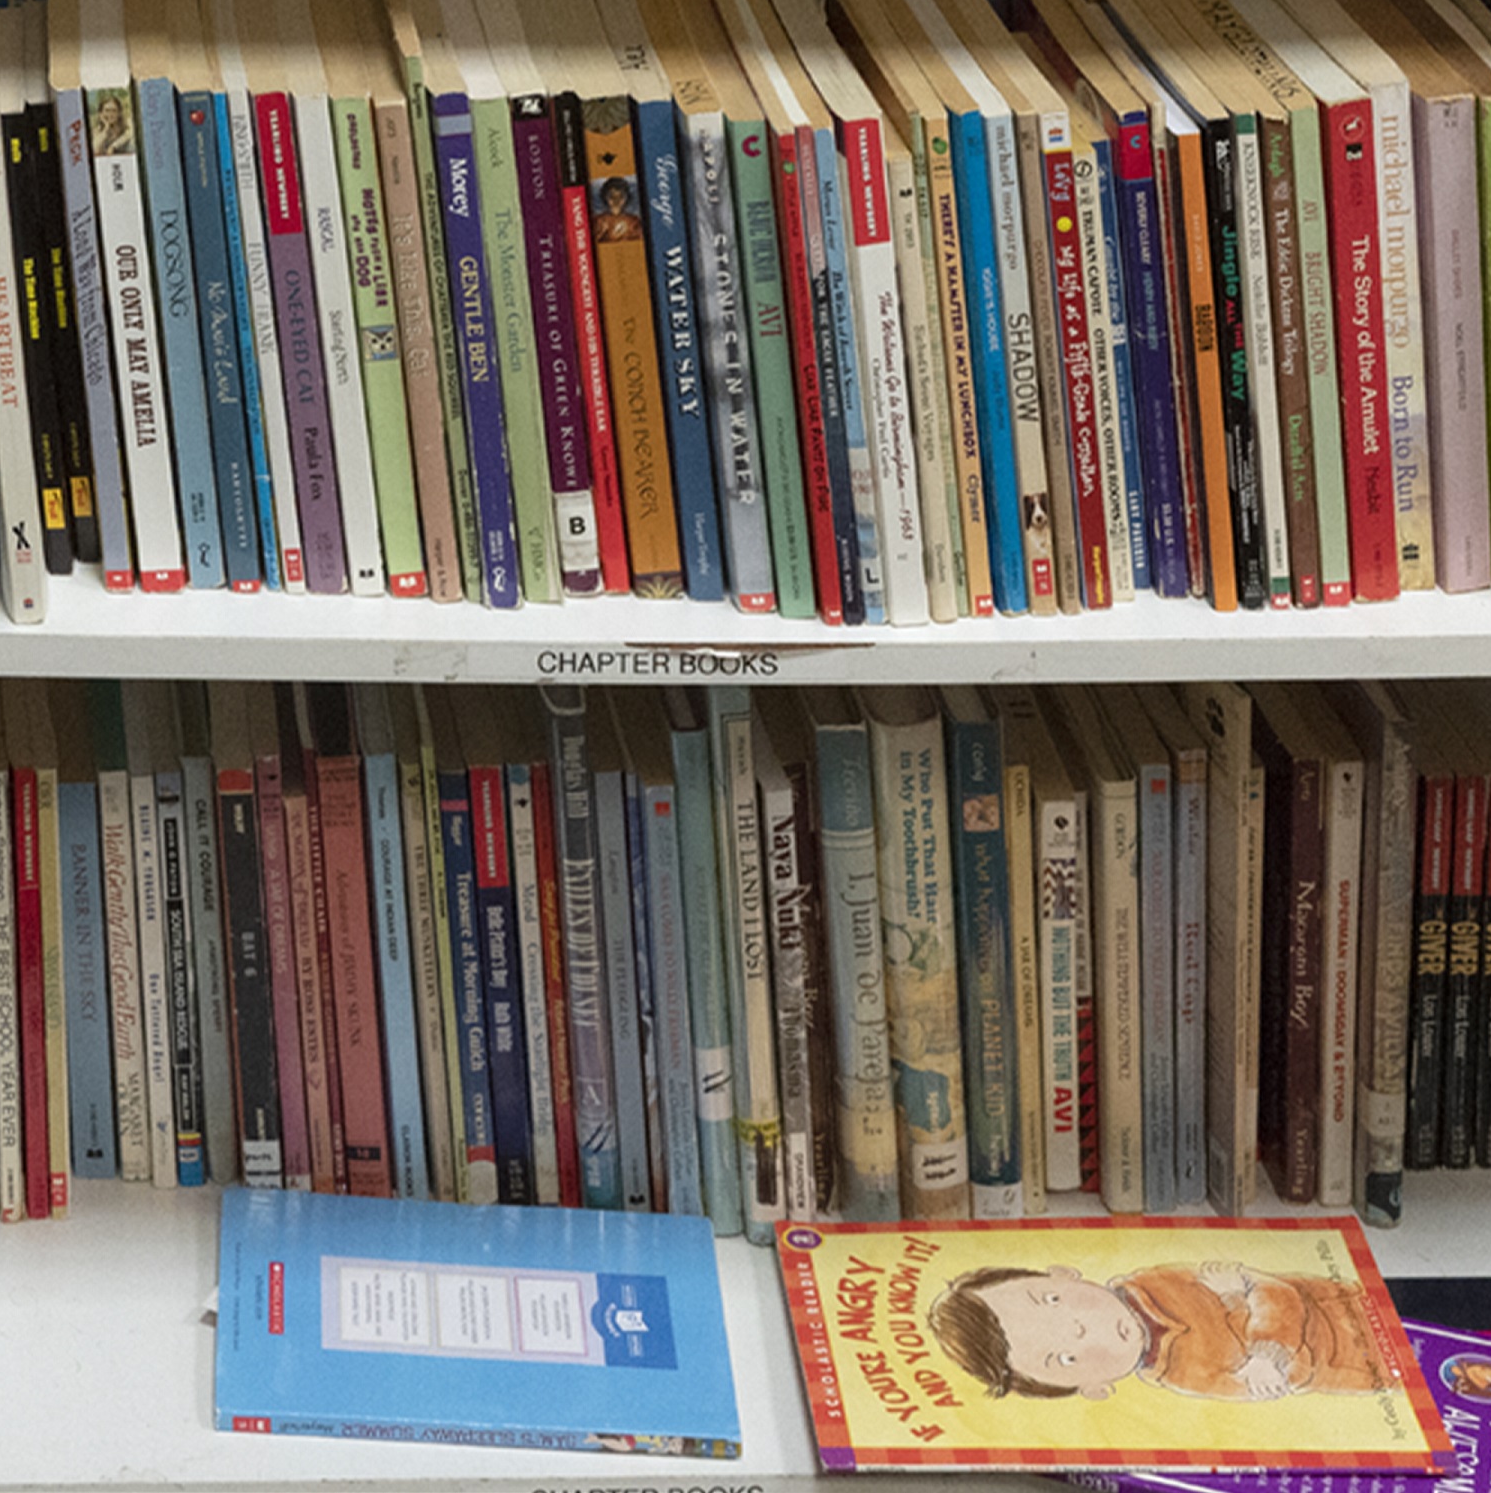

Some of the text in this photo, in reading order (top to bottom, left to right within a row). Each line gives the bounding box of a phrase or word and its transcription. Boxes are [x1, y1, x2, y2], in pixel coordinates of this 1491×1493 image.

[448, 158, 471, 217] Morey
[116, 245, 156, 446] OUR ONLY MAY AMELIA
[460, 257, 488, 381] GENTLE BEN
[664, 246, 699, 417] WATER SKY
[1008, 312, 1038, 422] SHADOW
[1348, 235, 1379, 453] The Story of the Amulet
[1391, 376, 1419, 512] Born to Run
[537, 650, 779, 676] CHAPTER BOOKS
[1053, 1085, 1072, 1133] AVI
[797, 1262, 842, 1418] SCHOLASTIC READER
[837, 1254, 886, 1344] ANGRY
[888, 1234, 964, 1408] AND YOU KNOW IT!
[910, 1422, 945, 1443] IF
